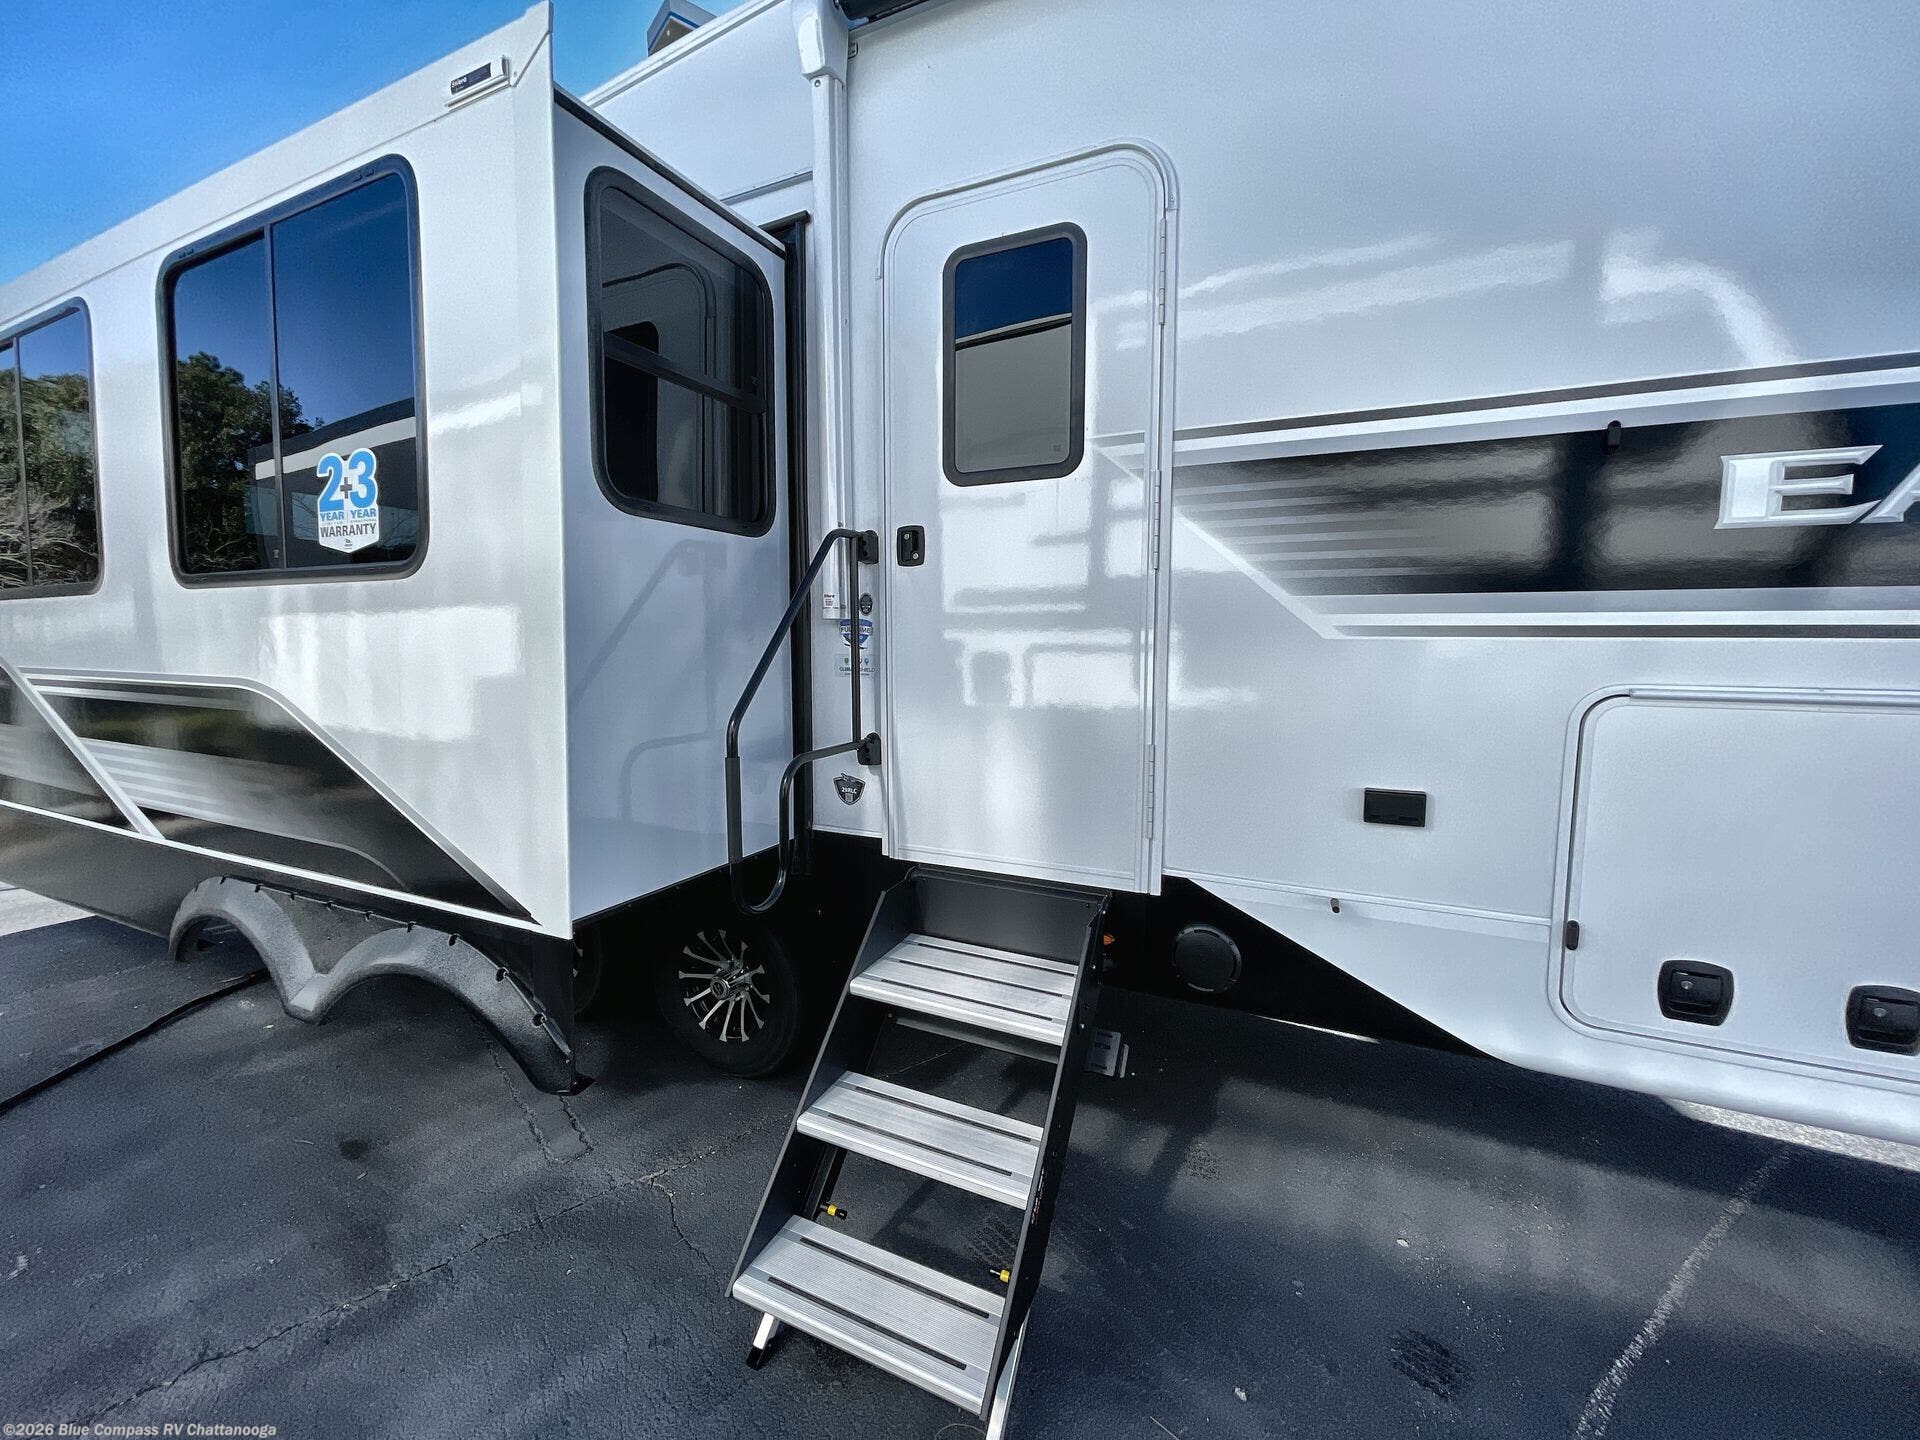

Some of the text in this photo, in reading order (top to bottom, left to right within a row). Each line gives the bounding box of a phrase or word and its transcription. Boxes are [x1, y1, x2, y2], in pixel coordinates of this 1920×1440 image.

[320, 511, 345, 522] YEAR
[350, 508, 377, 519] YEAR
[320, 523, 377, 538] WARRANTY
